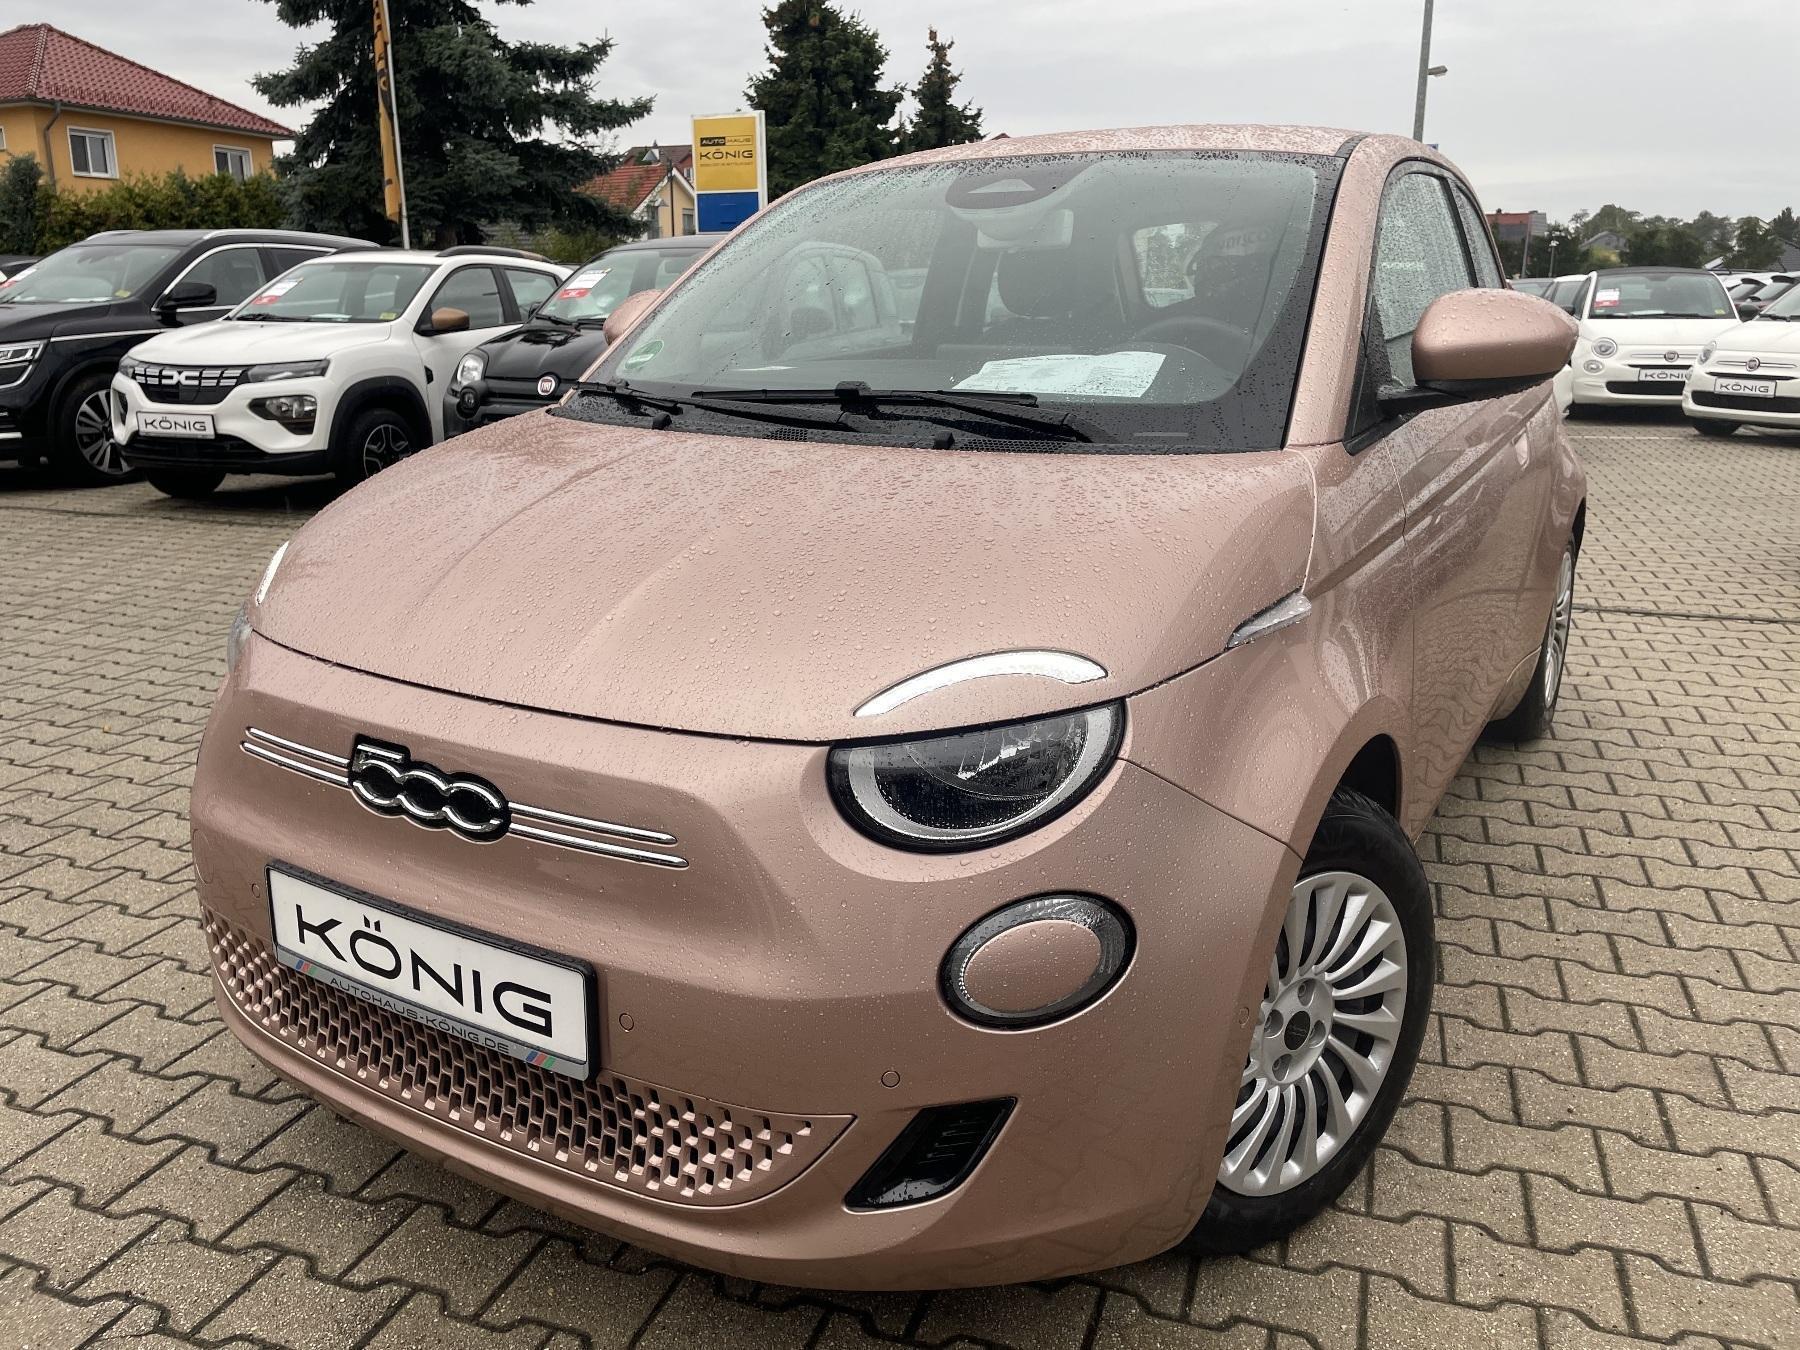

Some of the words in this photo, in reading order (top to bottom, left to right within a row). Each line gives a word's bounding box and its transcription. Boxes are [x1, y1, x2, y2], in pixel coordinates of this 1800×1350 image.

[700, 149, 753, 160] KÖNIG
[1720, 383, 1769, 393] KÖNIG
[144, 417, 206, 432] KÖNIG
[350, 737, 510, 840] 500
[296, 904, 552, 1038] KÖNIG
